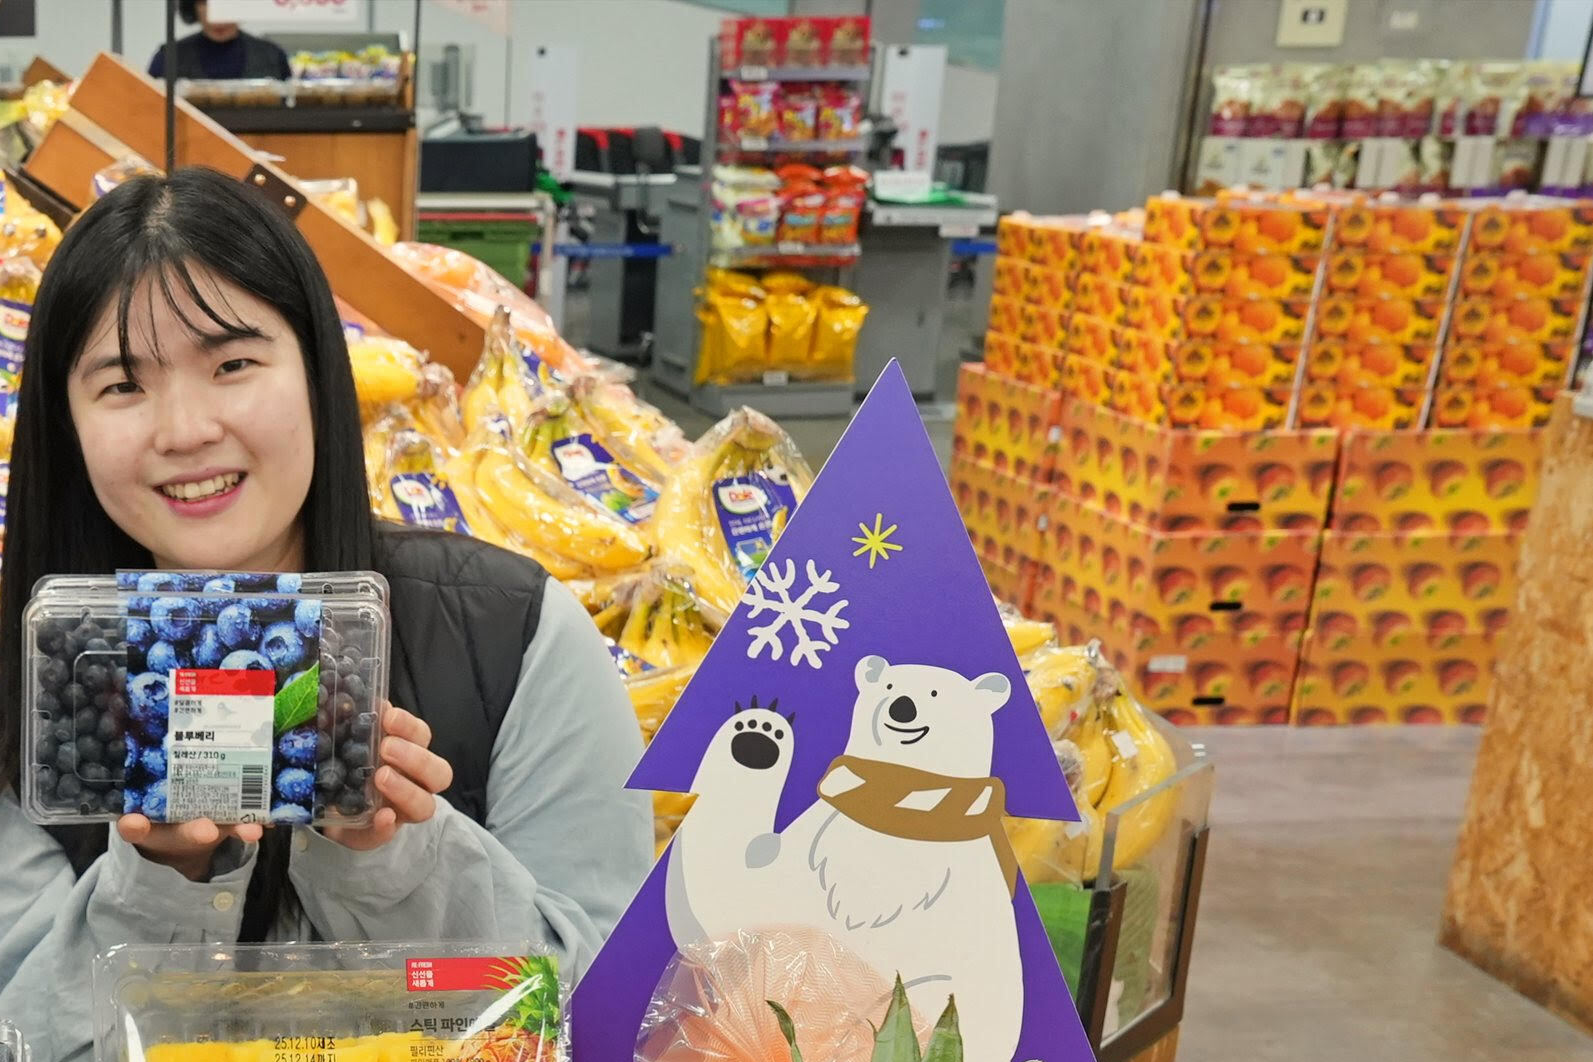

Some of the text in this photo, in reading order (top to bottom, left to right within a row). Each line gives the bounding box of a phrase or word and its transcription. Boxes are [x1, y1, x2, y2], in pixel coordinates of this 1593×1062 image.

[174, 731, 215, 741] 블루베리
[408, 1001, 445, 1009] #간편하게
[410, 1018, 437, 1032] 스틱
[275, 1036, 336, 1050] 25.12.10제조
[410, 1045, 444, 1057] 필리핀산
